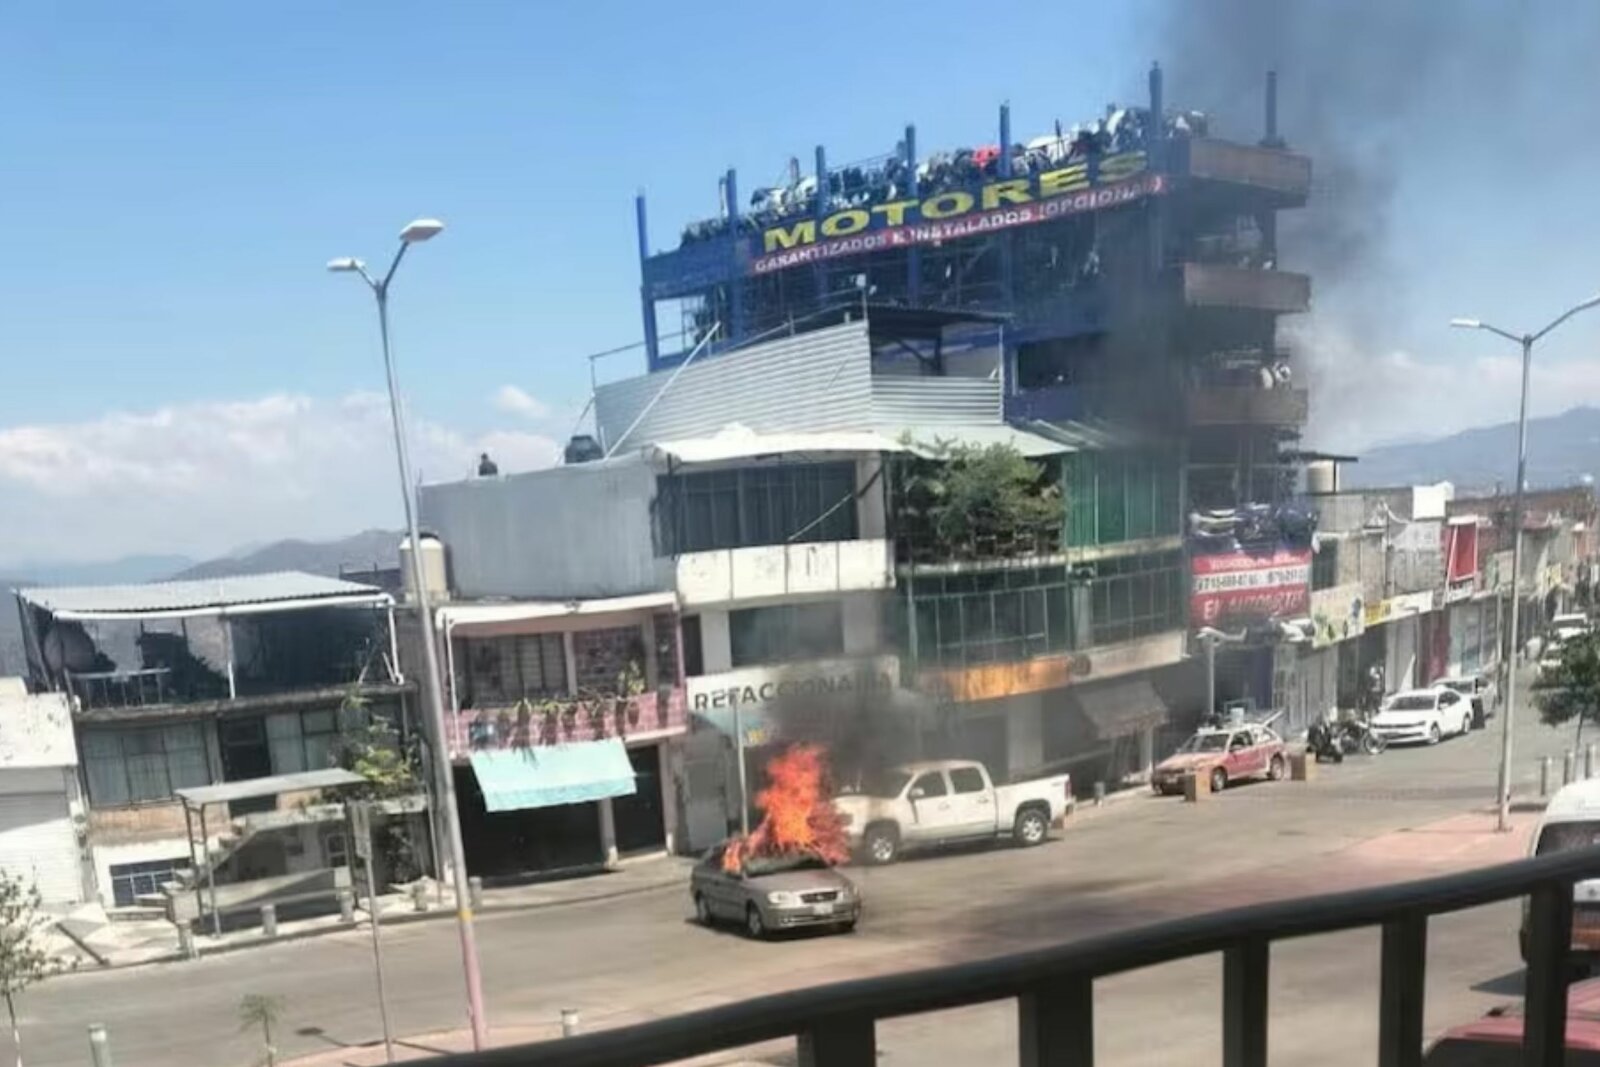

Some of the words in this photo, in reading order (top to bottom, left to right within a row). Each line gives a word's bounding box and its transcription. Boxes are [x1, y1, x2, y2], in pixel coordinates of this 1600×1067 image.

[764, 150, 1148, 253] MOTORES
[755, 235, 887, 273] GARANTIZADOS
[694, 671, 892, 711] REFACCIONAA
